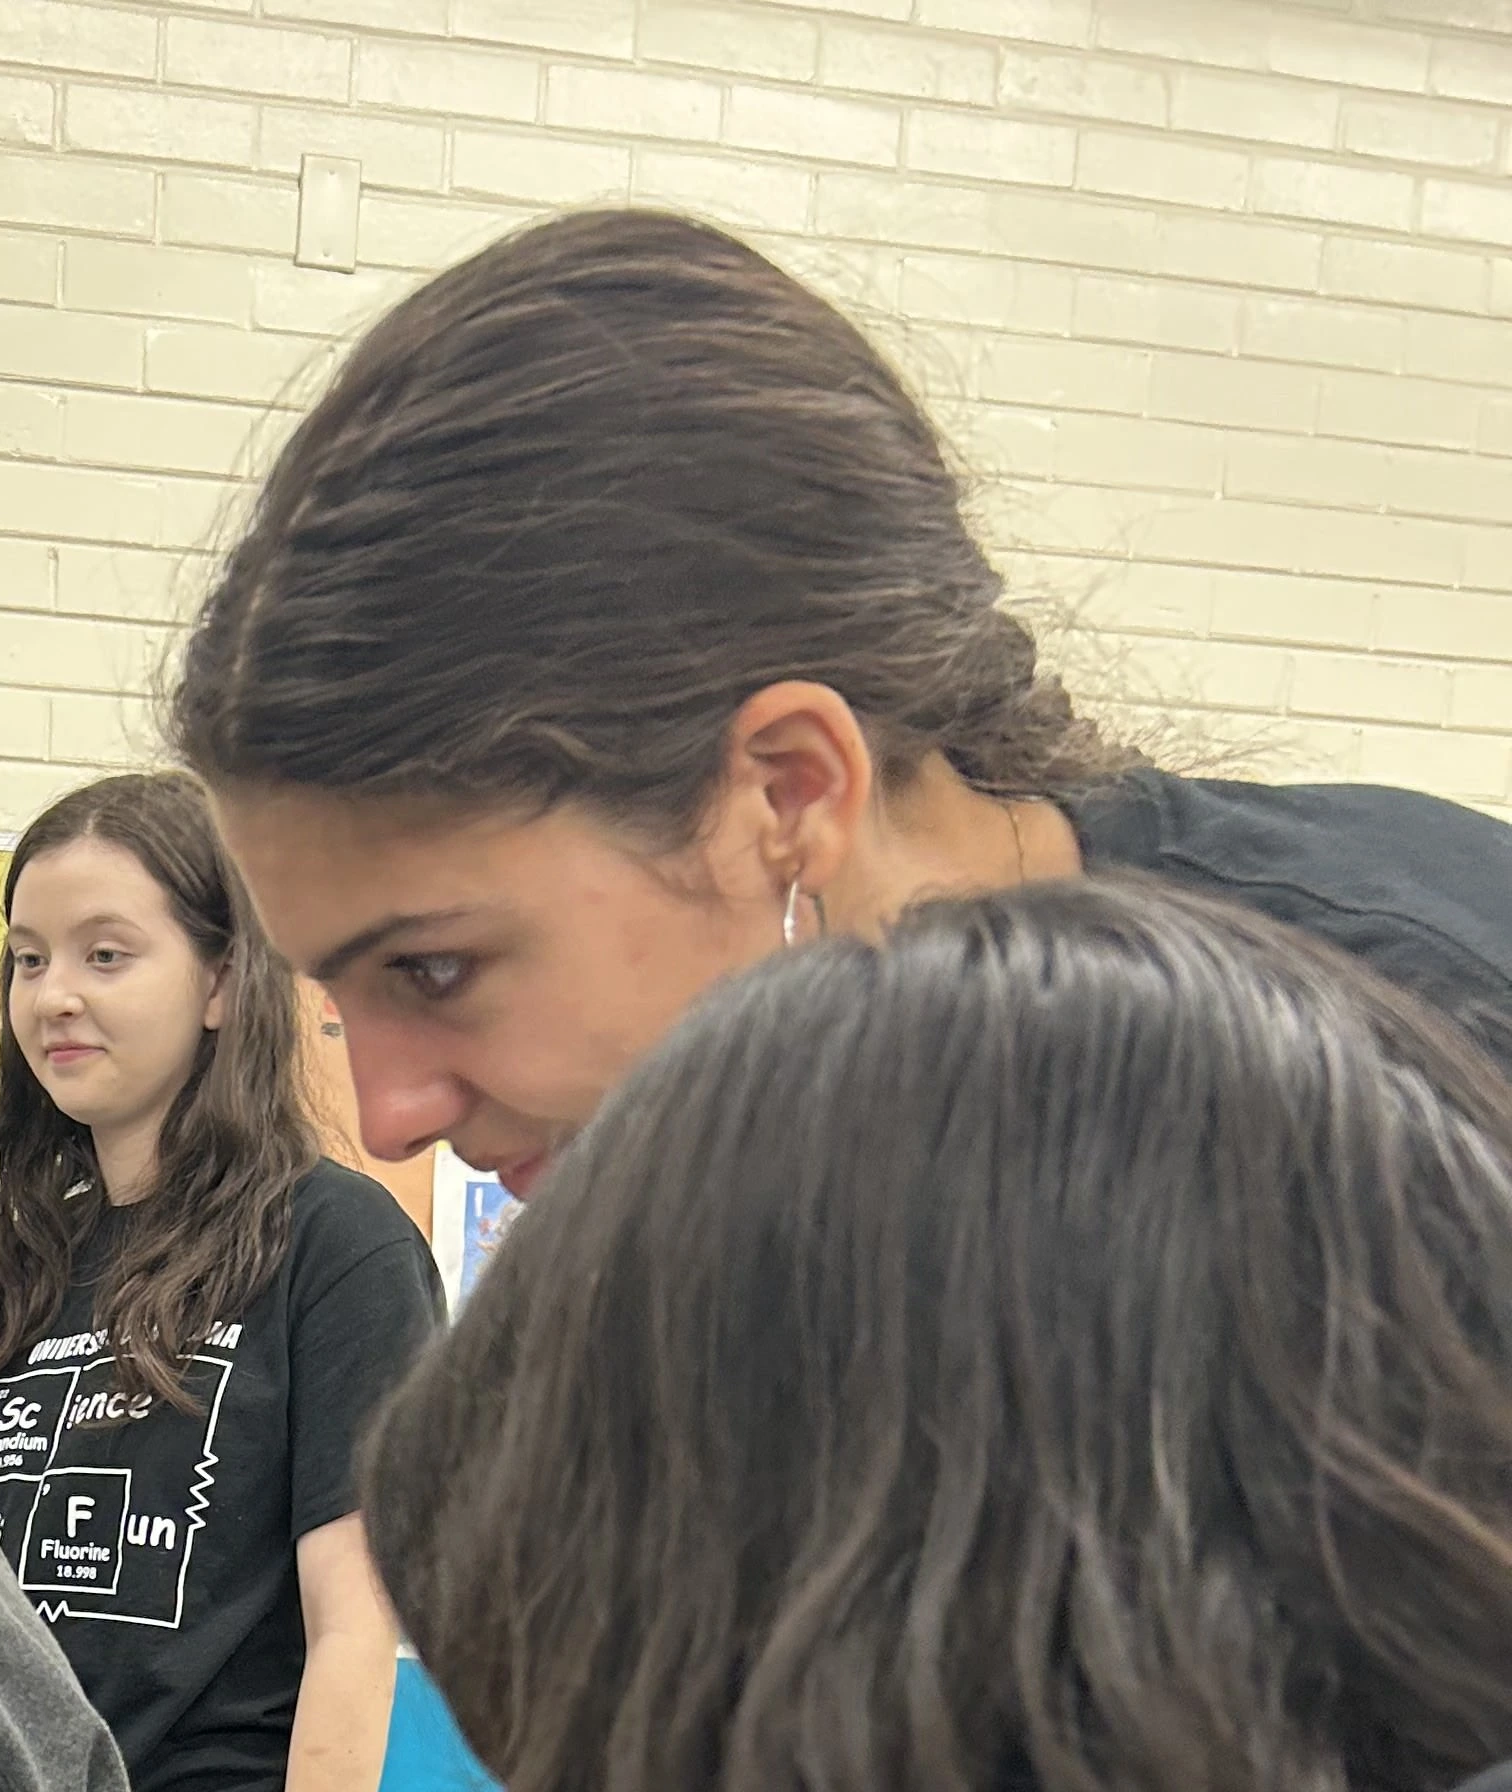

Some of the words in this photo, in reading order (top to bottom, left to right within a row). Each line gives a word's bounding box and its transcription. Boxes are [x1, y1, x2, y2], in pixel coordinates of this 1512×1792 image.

[66, 1495, 96, 1538] F
[126, 1513, 177, 1551] un
[40, 1537, 111, 1562] Fluorine
[56, 1564, 97, 1580] 18.998
